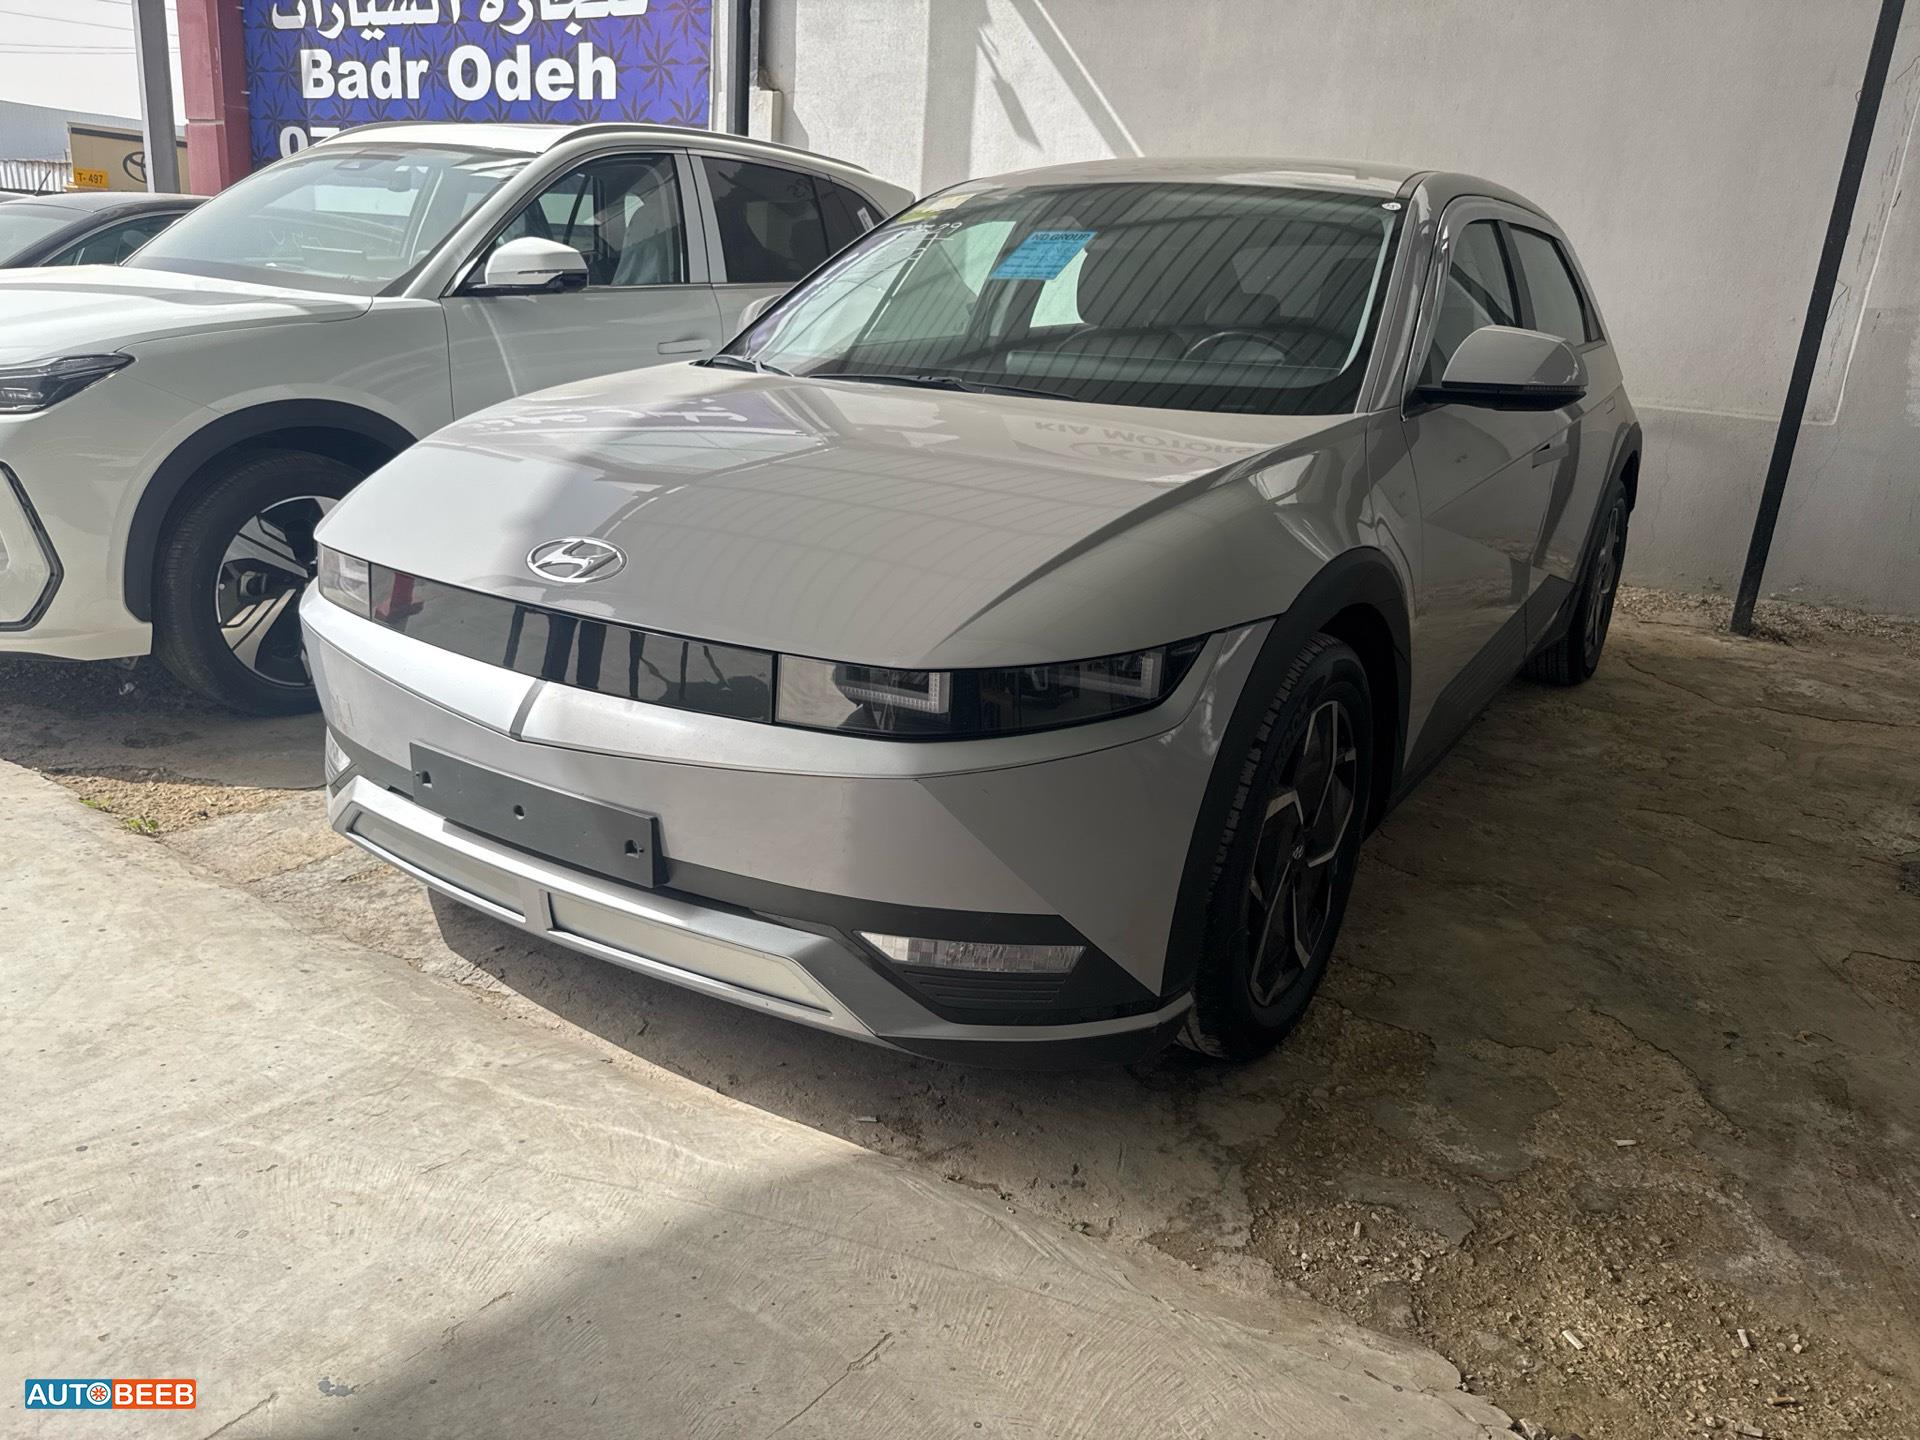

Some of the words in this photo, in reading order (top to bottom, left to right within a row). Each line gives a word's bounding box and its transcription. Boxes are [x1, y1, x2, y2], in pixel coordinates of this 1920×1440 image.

[300, 48, 428, 100] Badr
[447, 42, 617, 101] Odeh
[280, 125, 340, 158] 0
